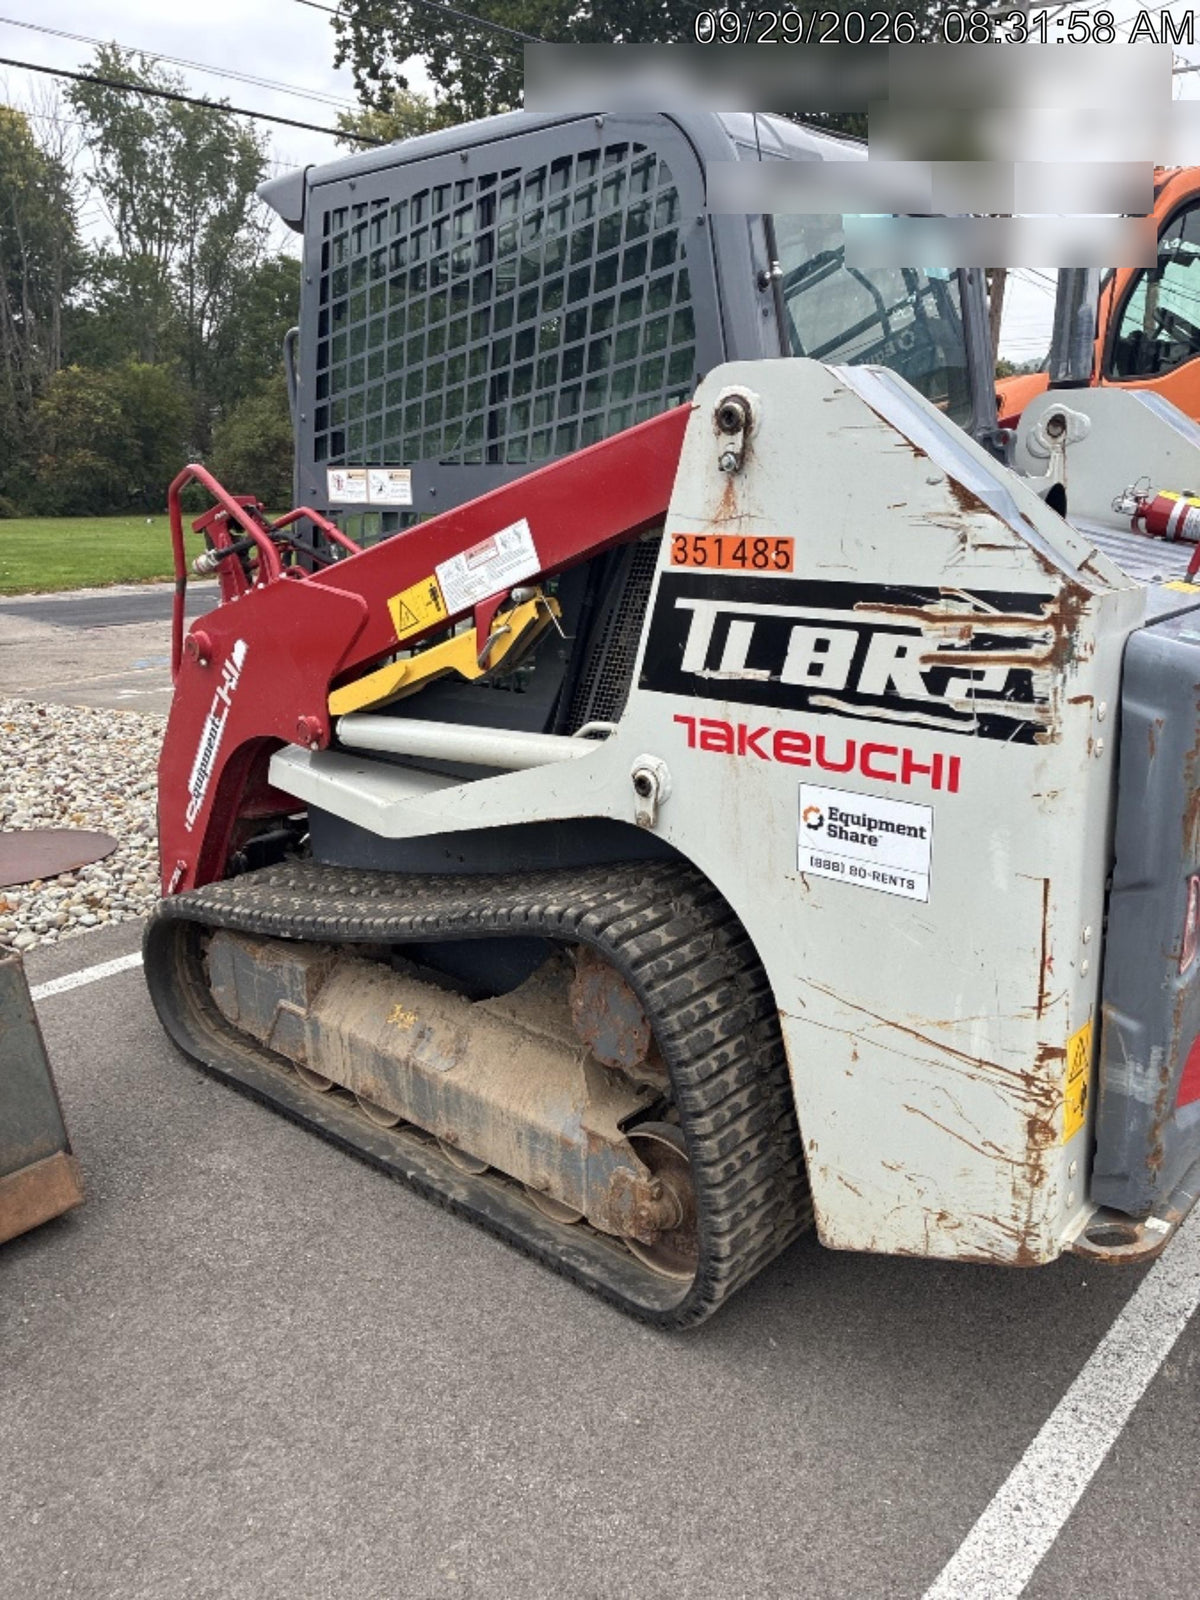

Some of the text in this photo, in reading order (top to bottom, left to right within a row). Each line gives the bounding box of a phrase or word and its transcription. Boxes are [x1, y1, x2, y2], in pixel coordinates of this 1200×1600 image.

[673, 535, 791, 570] 351485
[827, 824, 879, 847] Share
[828, 806, 927, 840] Equipment
[810, 855, 916, 891] (888) 80-RENTS
